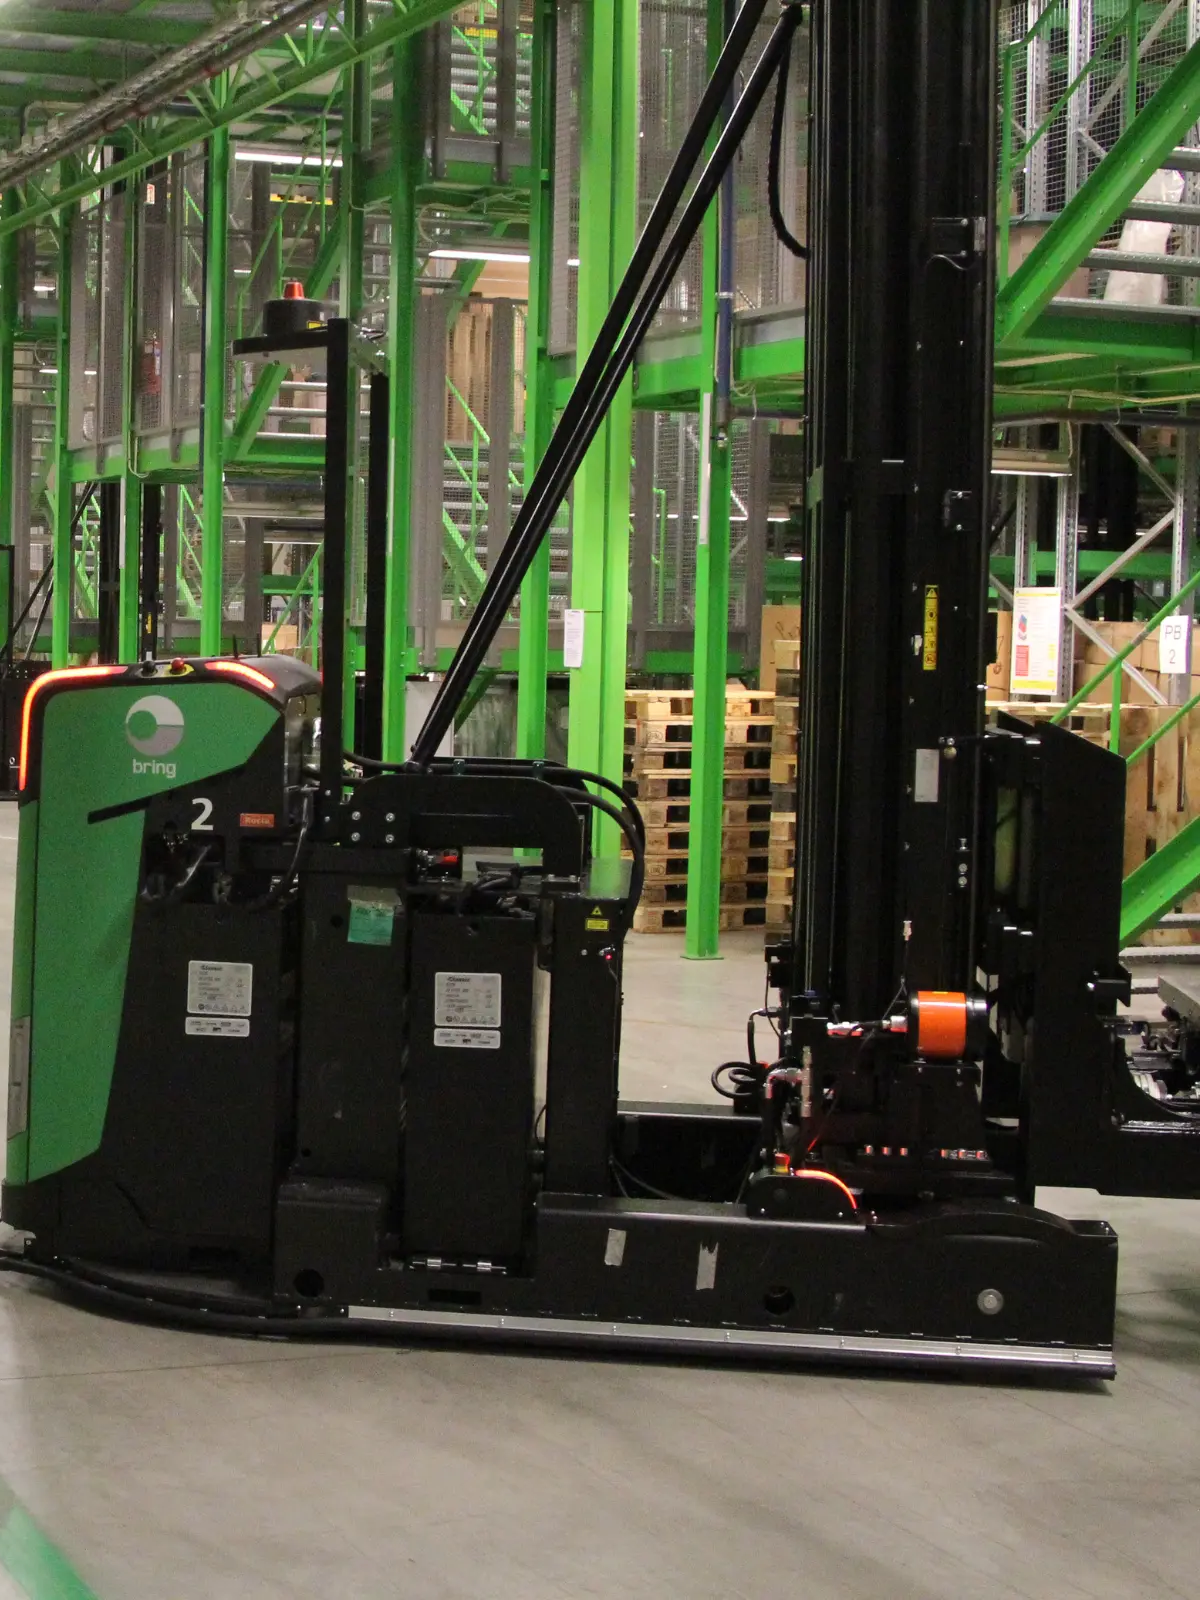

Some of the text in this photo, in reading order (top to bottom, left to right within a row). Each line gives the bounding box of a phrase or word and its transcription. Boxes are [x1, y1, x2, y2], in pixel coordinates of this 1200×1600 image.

[1165, 625, 1182, 640] PB
[1169, 649, 1176, 664] 2
[133, 759, 176, 779] bring
[191, 798, 213, 830] 2
